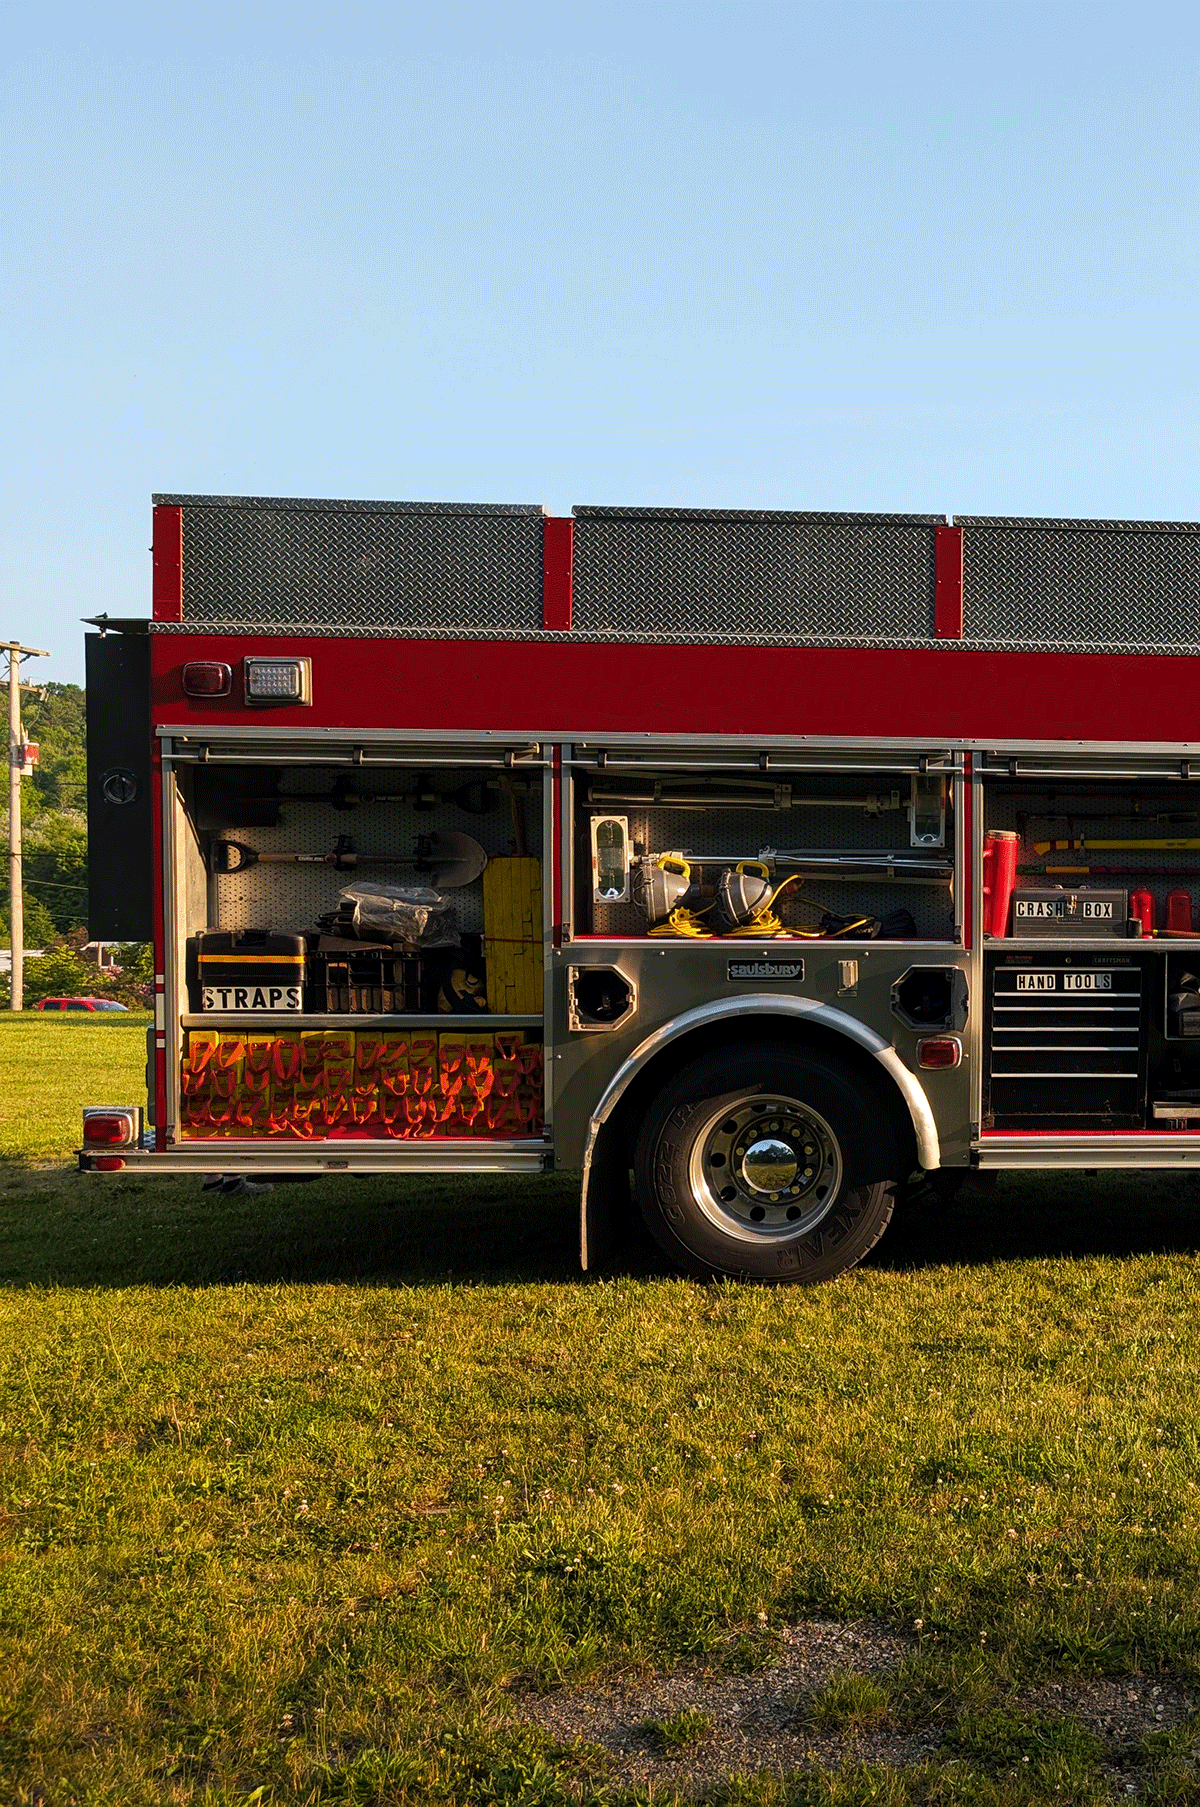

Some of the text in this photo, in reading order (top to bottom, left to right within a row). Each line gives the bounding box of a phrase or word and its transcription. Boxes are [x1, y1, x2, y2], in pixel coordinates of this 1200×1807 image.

[1017, 902, 1111, 917] CRASH BOX
[1018, 974, 1110, 989] HAND TOOLS
[203, 988, 300, 1009] STRAPS
